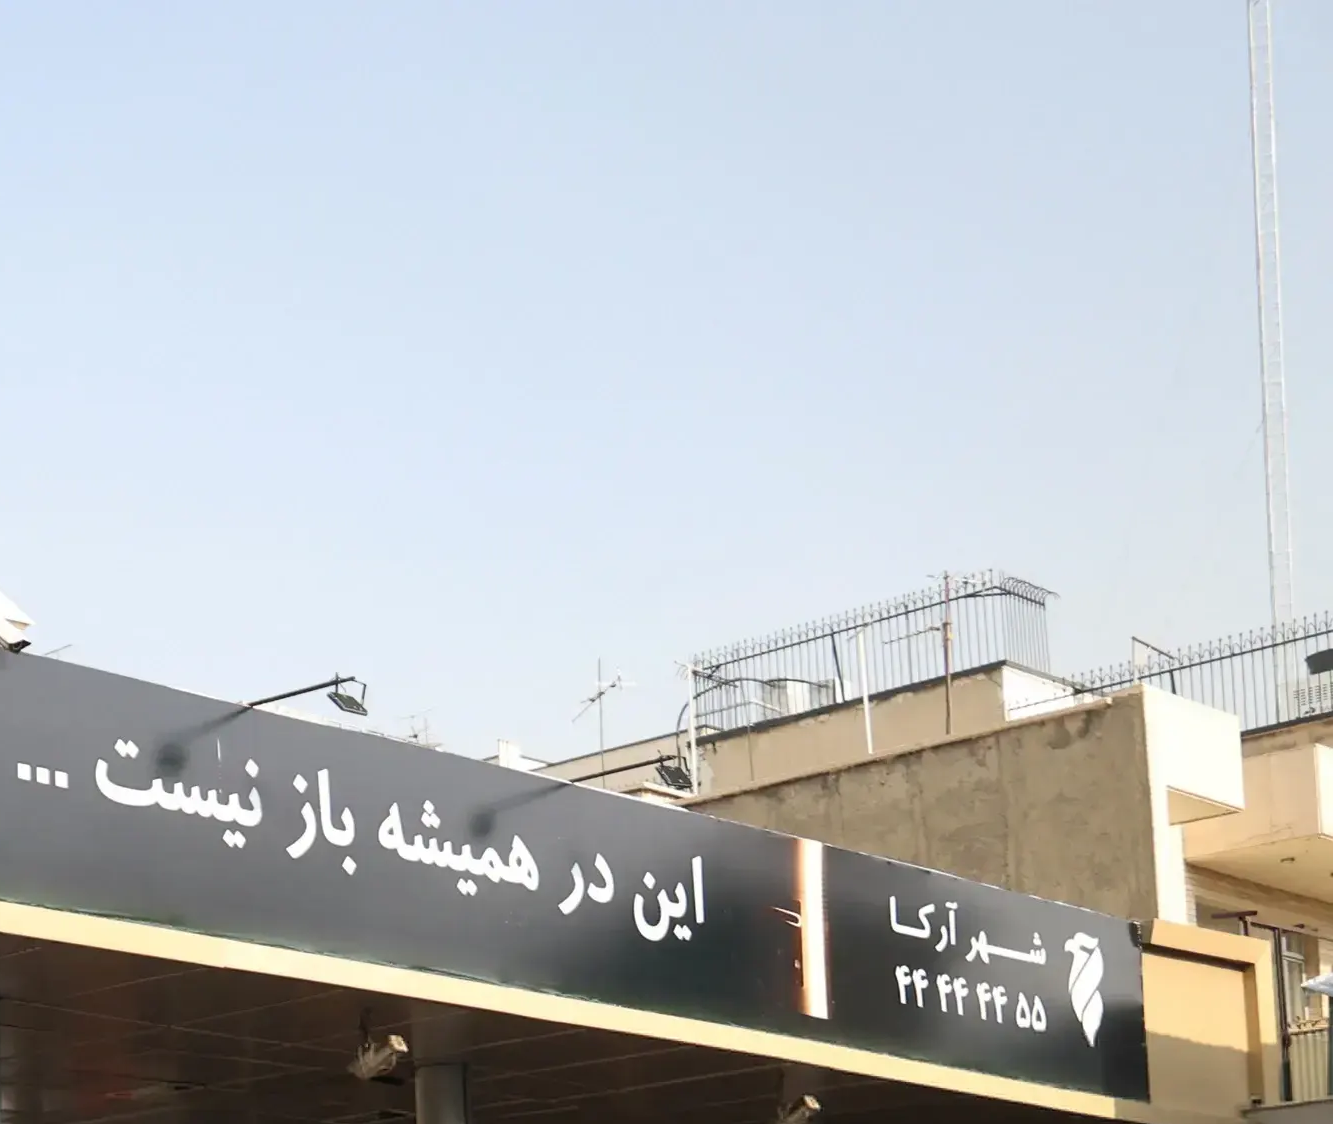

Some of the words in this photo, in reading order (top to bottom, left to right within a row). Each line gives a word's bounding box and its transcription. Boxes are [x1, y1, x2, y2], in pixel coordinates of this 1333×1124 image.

[95, 739, 262, 848] نیست
[286, 769, 356, 875] باز
[378, 800, 539, 895] همیشه
[558, 853, 614, 915] در
[634, 856, 705, 941] این
[890, 896, 958, 951] آرکا
[965, 931, 1046, 965] شهر
[895, 965, 928, 1008] ۴۴
[937, 974, 969, 1016] ۴۴
[976, 982, 1008, 1024] ۴۴
[1016, 992, 1047, 1032] ۵۵
